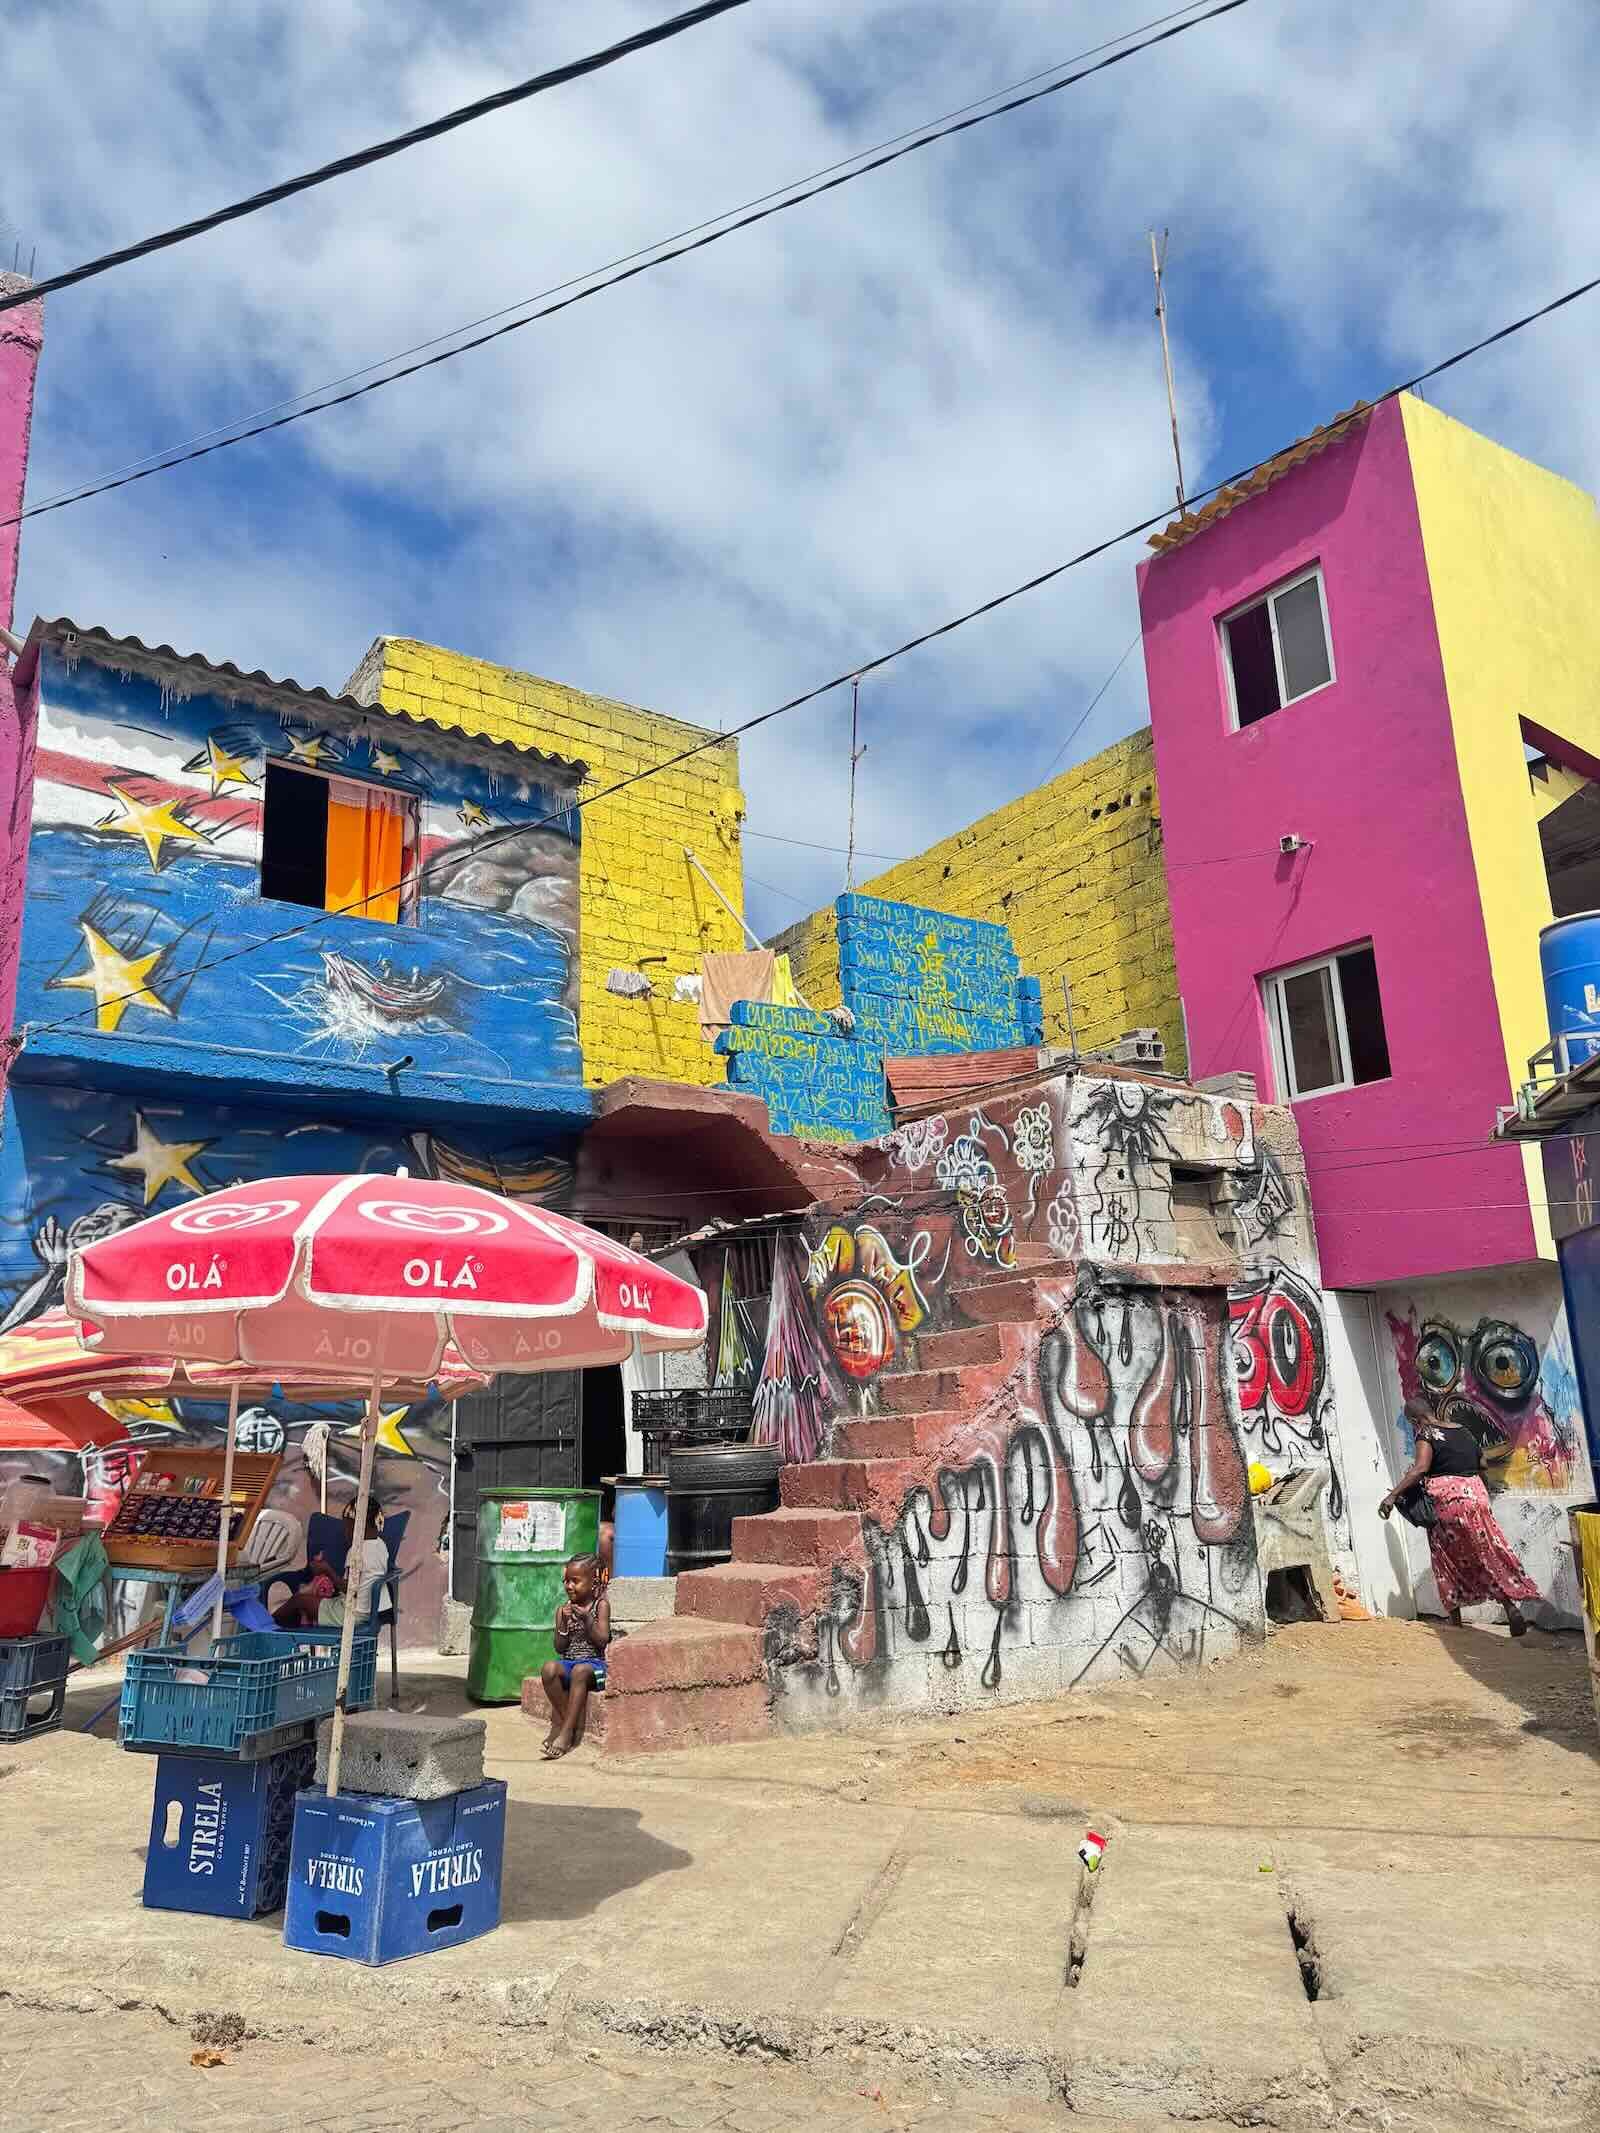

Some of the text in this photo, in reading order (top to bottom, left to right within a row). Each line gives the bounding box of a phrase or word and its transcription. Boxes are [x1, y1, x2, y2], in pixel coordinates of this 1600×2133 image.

[188, 1781, 223, 1876] STRELA
[307, 1858, 364, 1896] STRELA
[411, 1848, 484, 1897] STRELA
